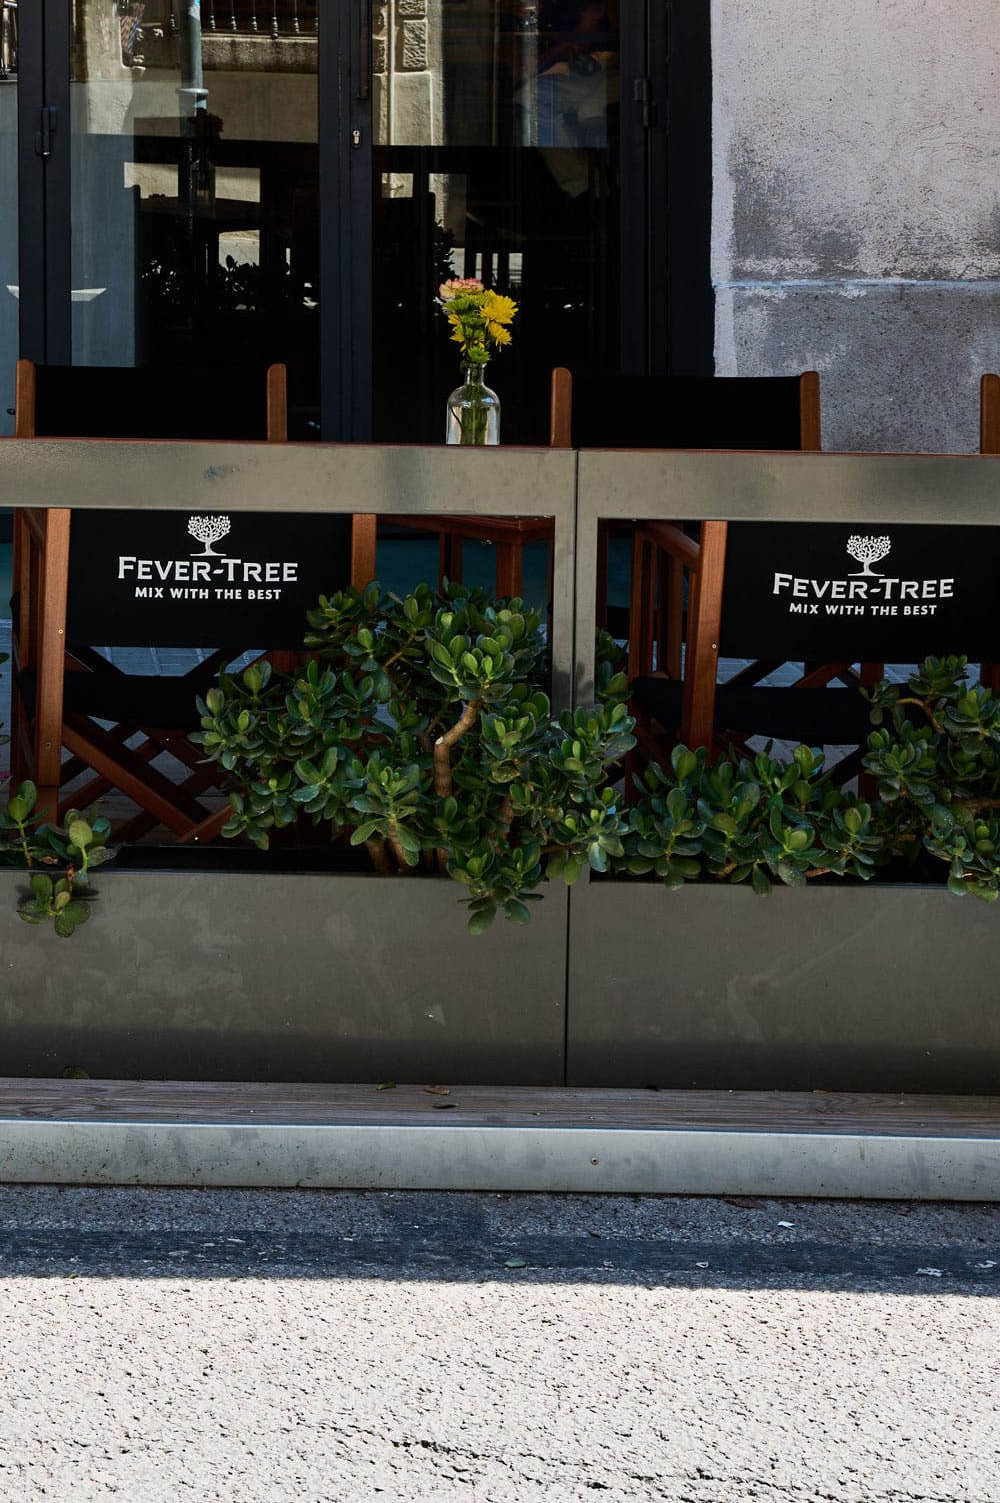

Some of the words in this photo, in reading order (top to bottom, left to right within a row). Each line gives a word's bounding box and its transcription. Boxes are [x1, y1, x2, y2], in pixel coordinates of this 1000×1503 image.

[117, 556, 298, 582] FEVER-TREE
[134, 586, 164, 598] MIX
[169, 587, 209, 600] WITH
[214, 588, 242, 600] THE
[247, 589, 282, 600] BEST
[772, 572, 955, 599] FEVER-TREE
[789, 602, 819, 615] MIX
[825, 604, 865, 615] WITH
[870, 605, 898, 616] THE
[903, 605, 938, 616] BEST
